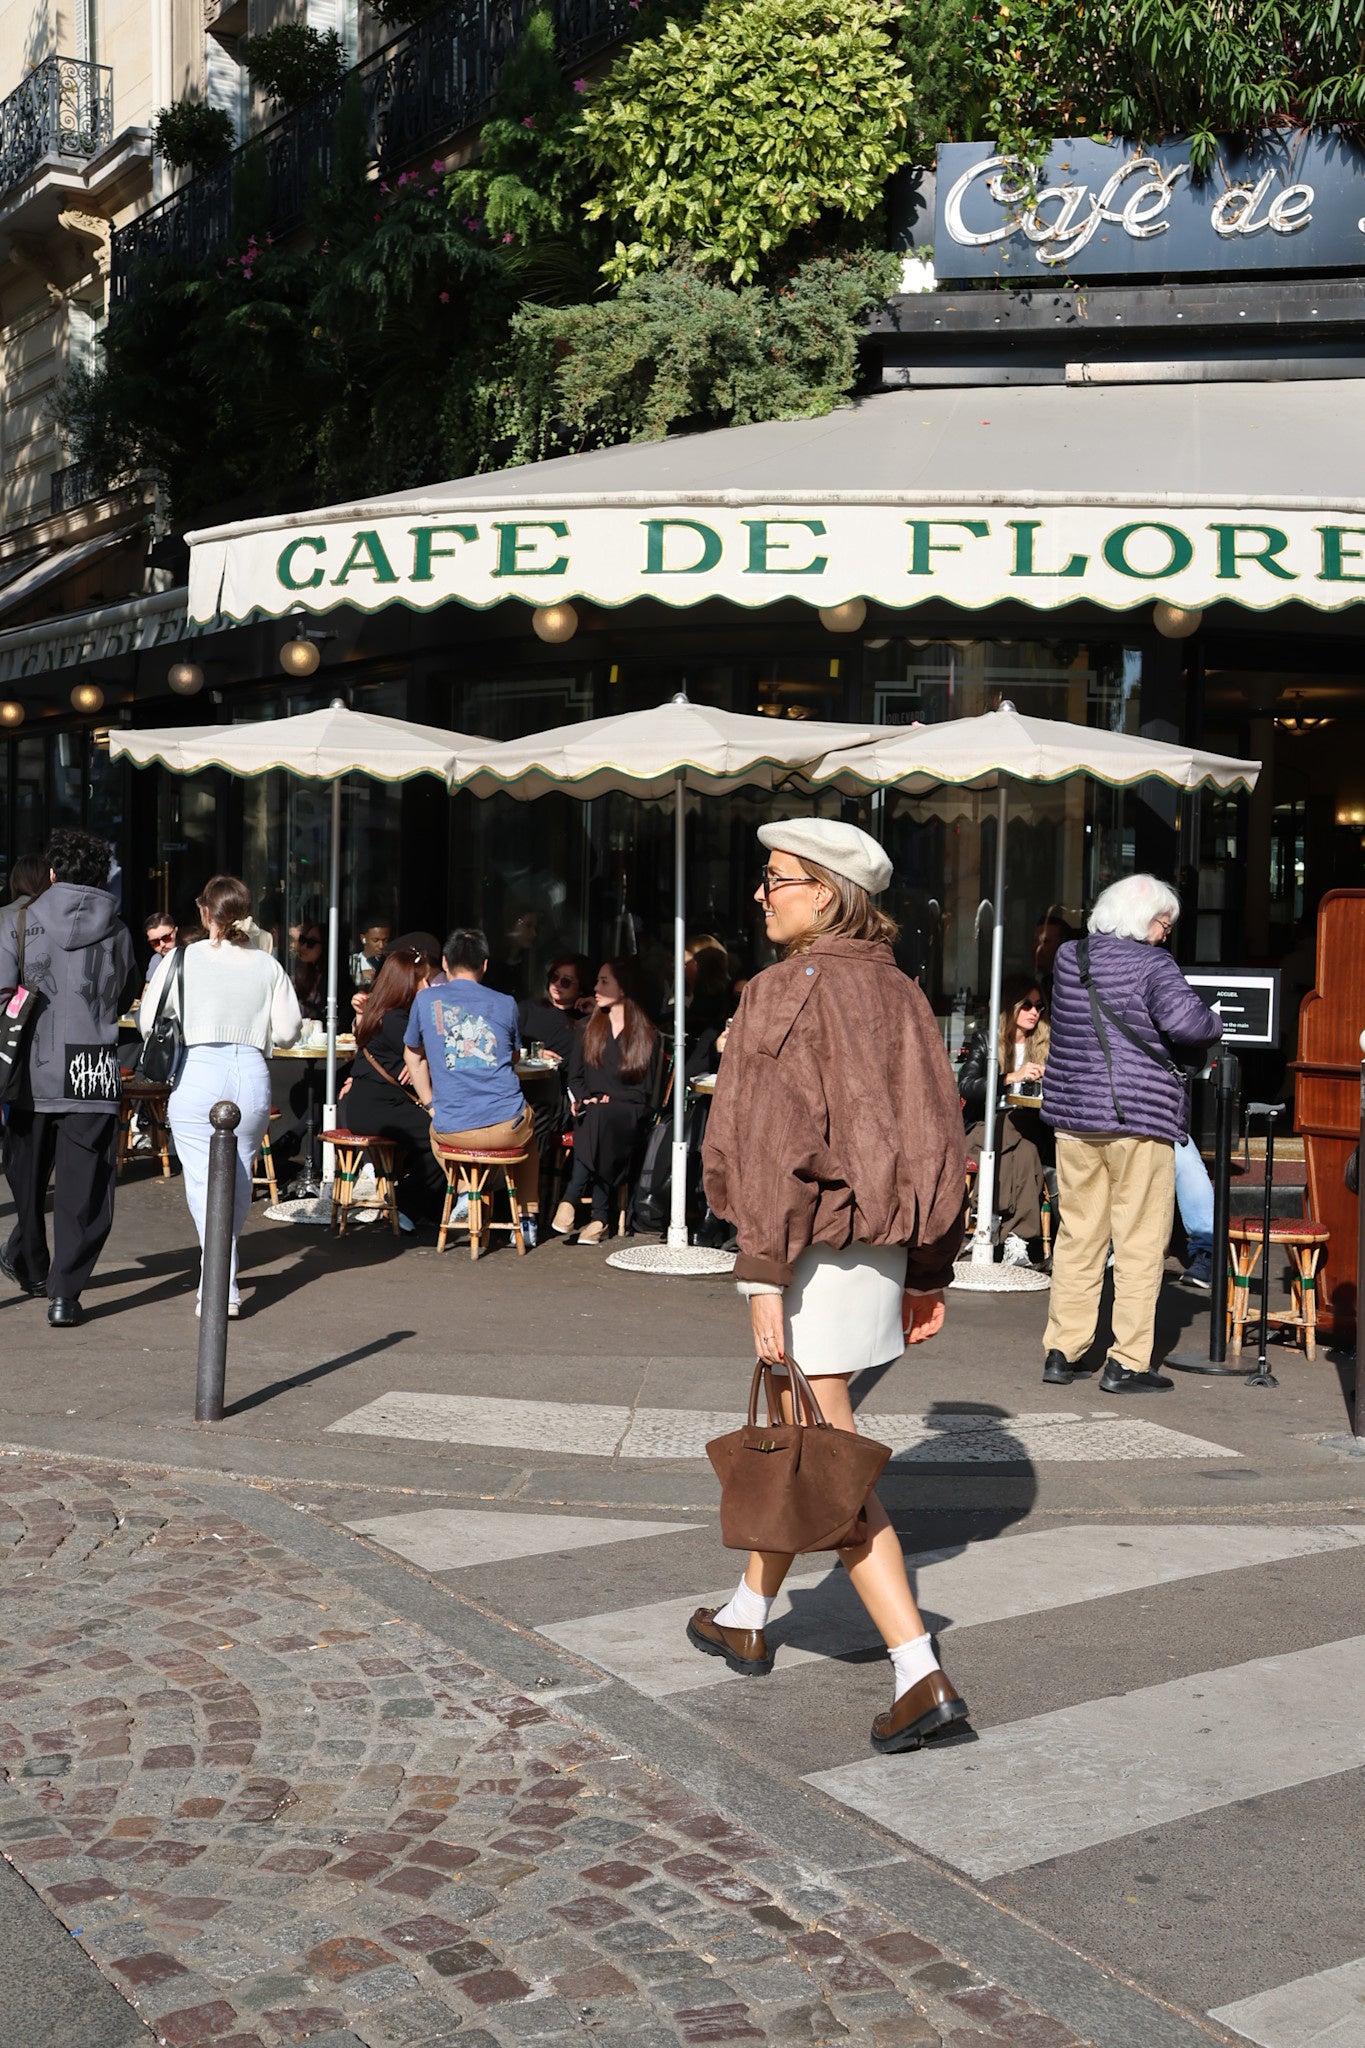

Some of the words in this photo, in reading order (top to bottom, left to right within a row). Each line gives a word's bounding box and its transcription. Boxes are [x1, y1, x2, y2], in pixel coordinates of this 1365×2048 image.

[1210, 169, 1315, 234] de
[275, 518, 571, 591] CAFE
[639, 518, 831, 577] DE
[904, 518, 1365, 583] FLORE
[887, 710, 925, 724] OULEVARD
